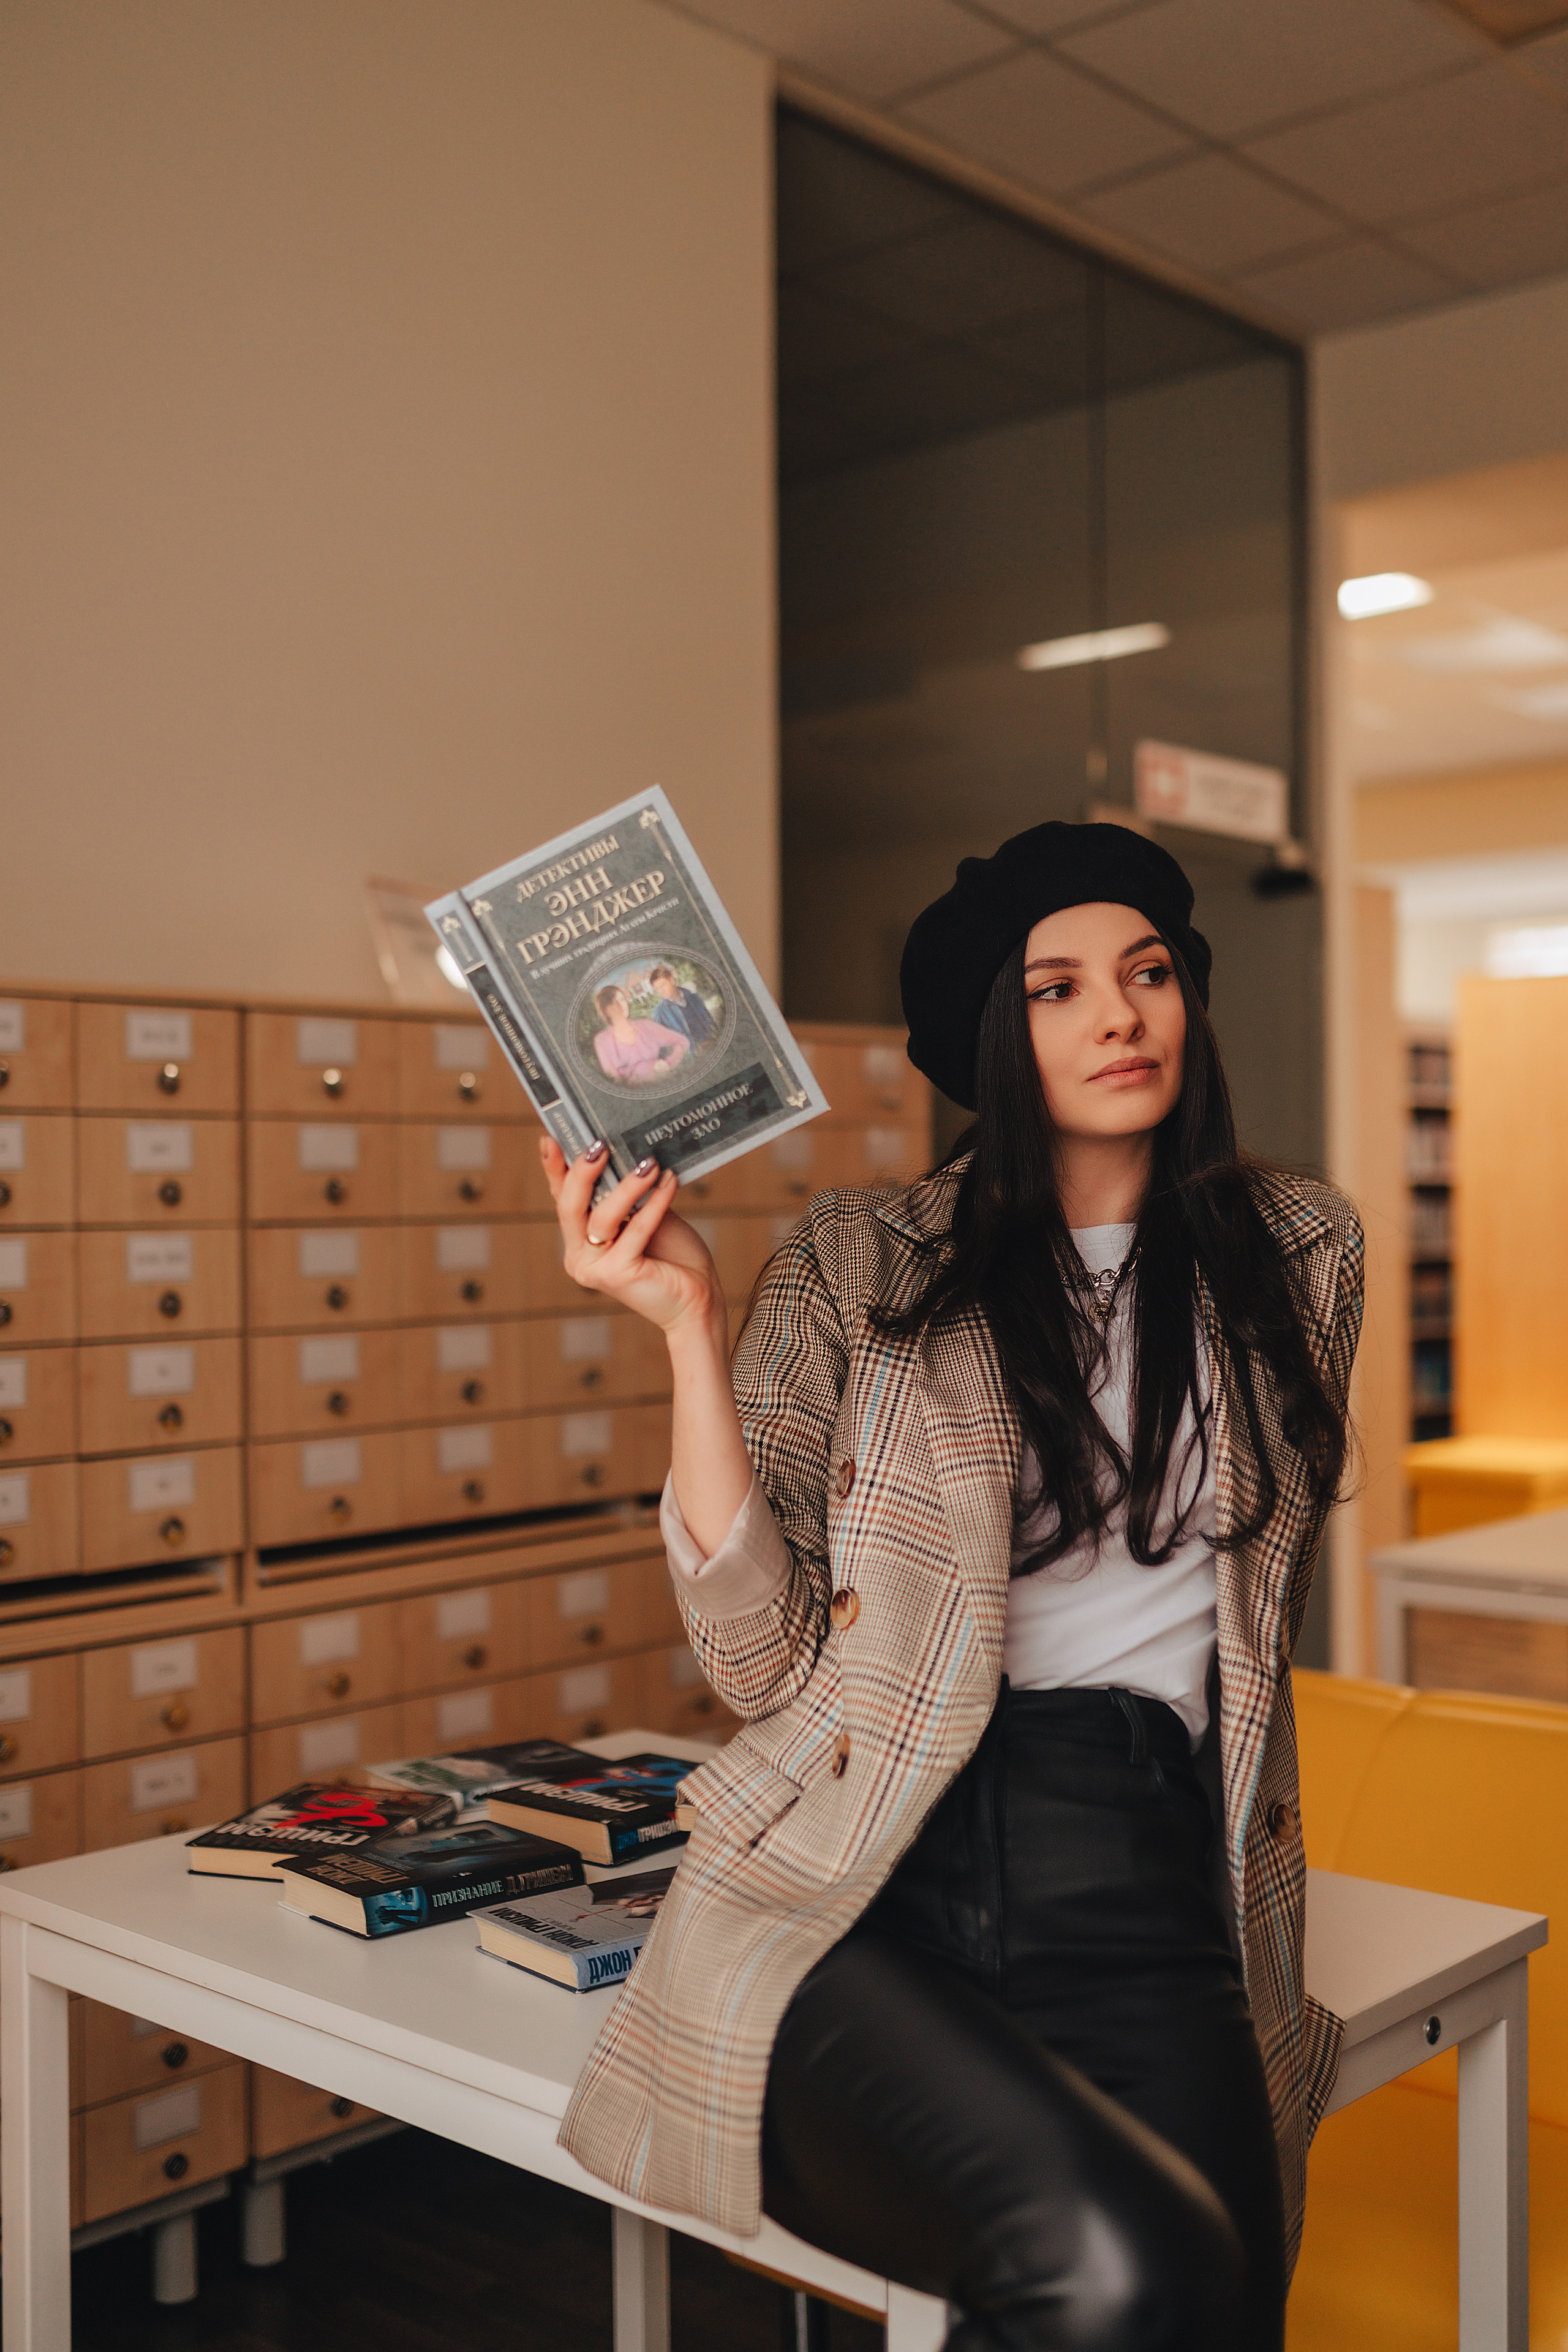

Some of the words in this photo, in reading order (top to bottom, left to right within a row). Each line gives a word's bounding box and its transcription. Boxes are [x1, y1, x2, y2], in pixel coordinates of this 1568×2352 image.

[517, 834, 620, 903] ДЕТЕКТИВЫ
[543, 865, 613, 917] ЭНН
[517, 870, 665, 965] ГРЭНДЖЕР
[486, 993, 503, 1015] ЗЛО
[498, 1014, 540, 1081] НЕУГОМОННОЕ
[643, 1080, 753, 1145] НЕУГОМОННОЕ
[691, 1117, 721, 1141] ЗЛО
[521, 1782, 649, 1812] ГРИШЭМ
[214, 1822, 371, 1846] ГРИШЭМ
[638, 1819, 680, 1843] ГРИШЭМ
[306, 1864, 370, 1885] ДЖОН
[317, 1853, 410, 1884] ГРИШЭМ
[432, 1880, 504, 1907] ПРИЗНАНИЕ
[488, 1907, 556, 1933] ГРИШЭМ
[542, 1929, 600, 1949] ДЖОН
[588, 1950, 631, 1984] ДЖОН
